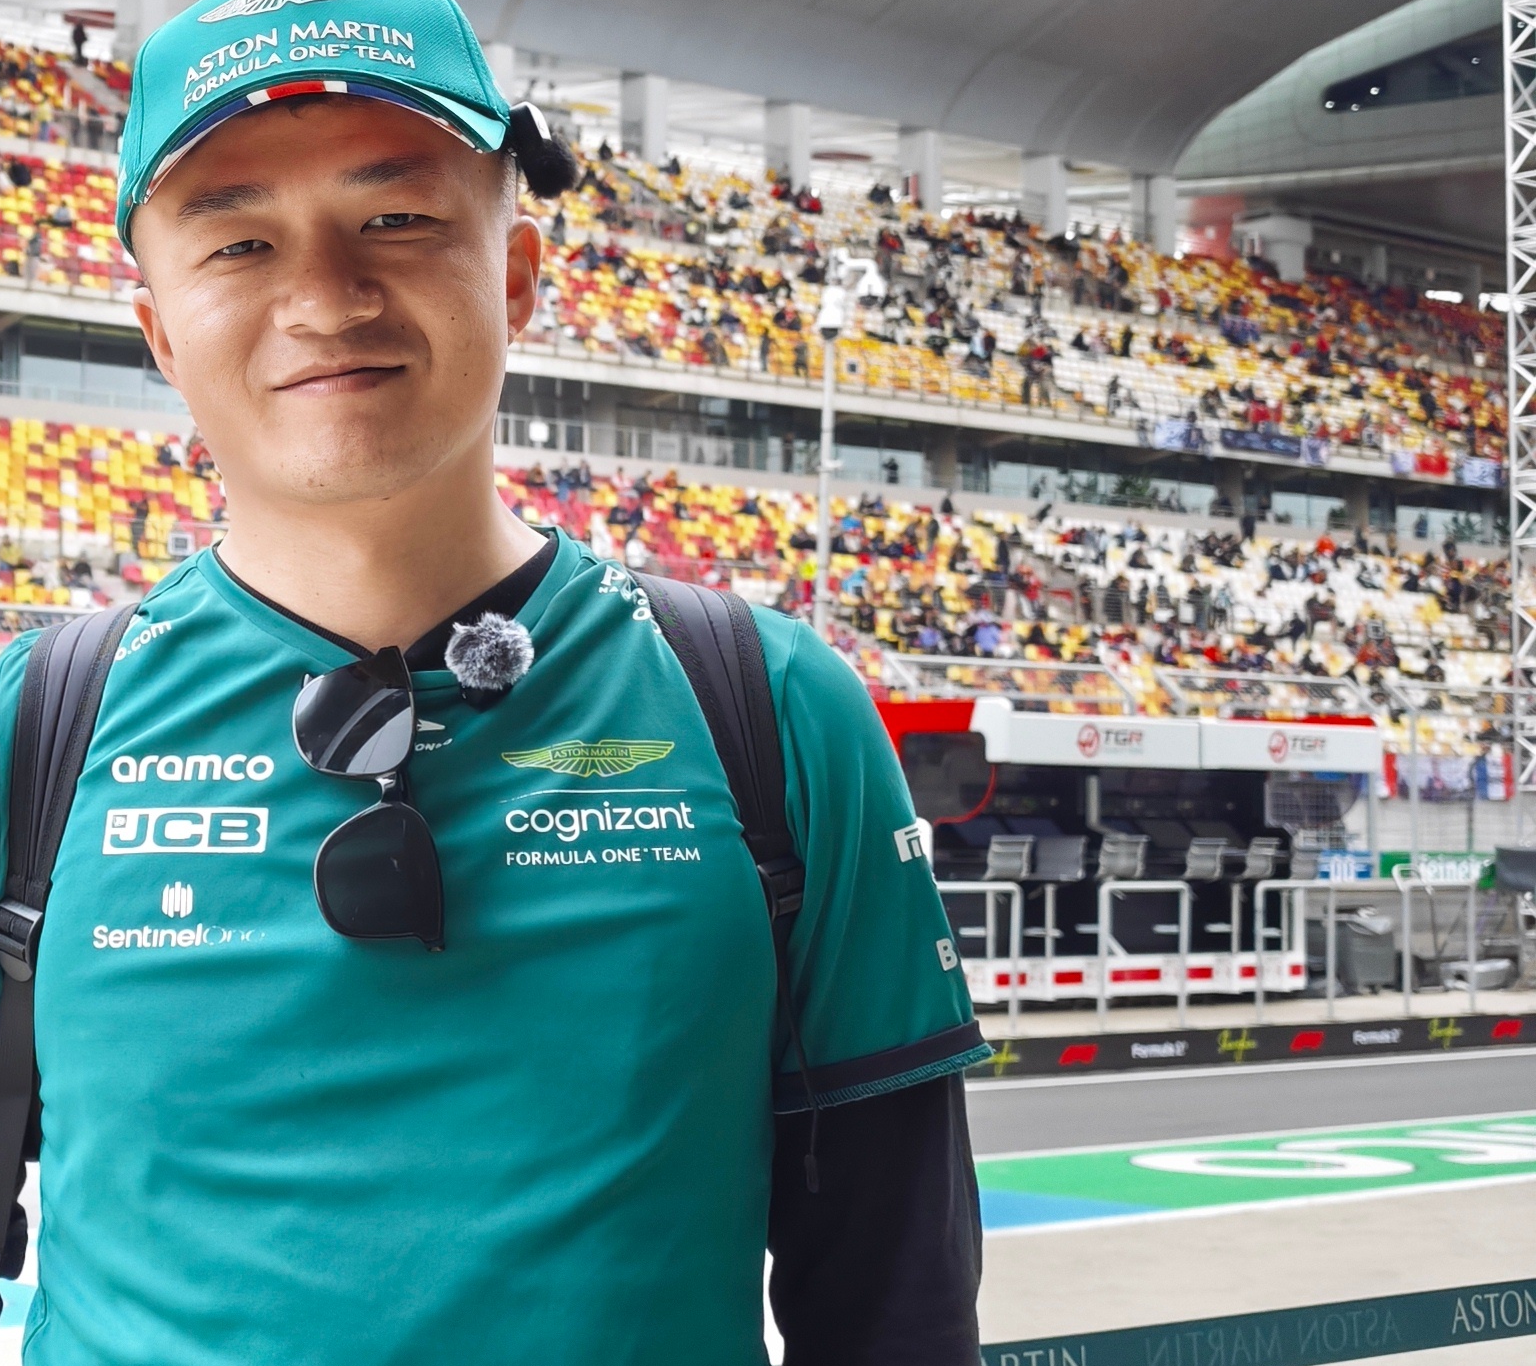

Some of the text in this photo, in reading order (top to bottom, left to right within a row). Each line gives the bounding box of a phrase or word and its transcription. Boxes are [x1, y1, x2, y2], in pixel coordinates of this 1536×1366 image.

[183, 19, 414, 91] ASTON MARTIN
[183, 52, 282, 111] FORMULA
[354, 45, 416, 68] TEAM
[111, 754, 275, 783] aramco
[552, 746, 629, 758] ASTON MARTIN
[110, 812, 261, 849] JCB
[505, 800, 694, 842] cognizant
[506, 850, 597, 866] FORMULA
[651, 847, 701, 862] TEAM
